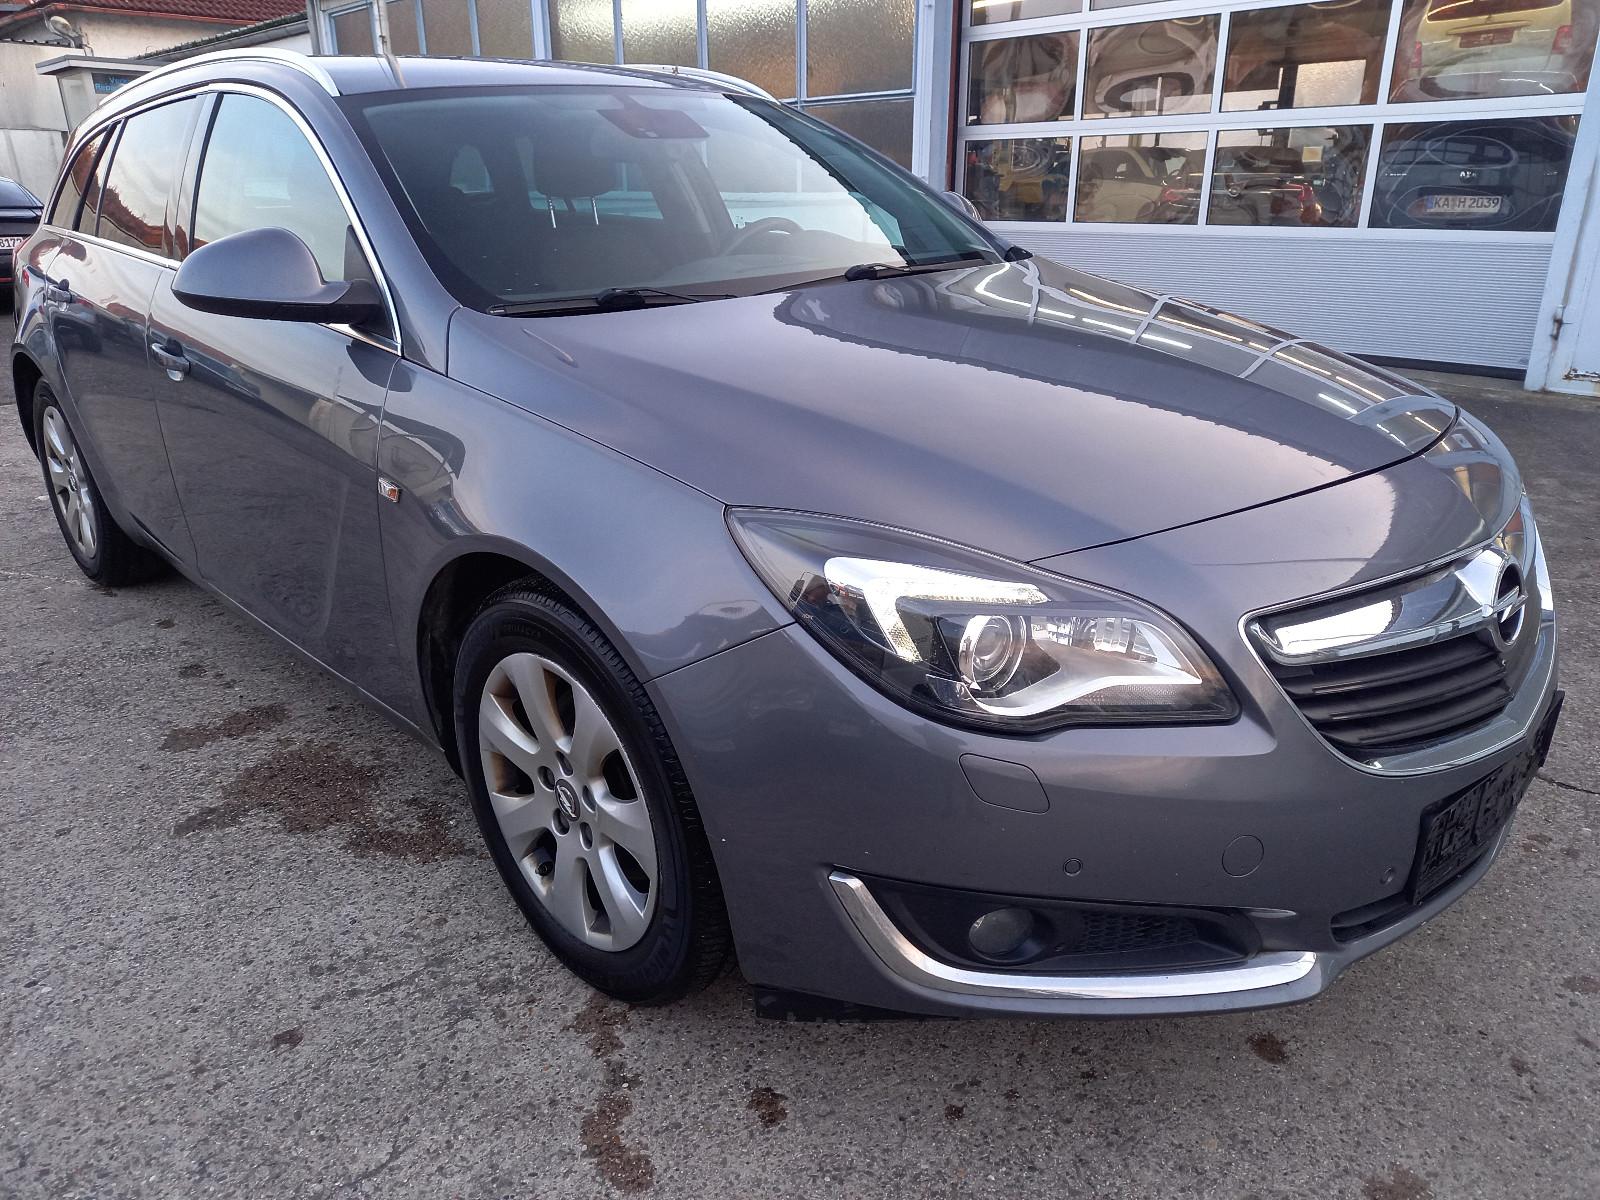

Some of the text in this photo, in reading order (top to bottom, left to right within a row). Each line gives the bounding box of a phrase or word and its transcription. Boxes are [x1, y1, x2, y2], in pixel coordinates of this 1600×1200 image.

[1433, 197, 1500, 209] KA H 2039
